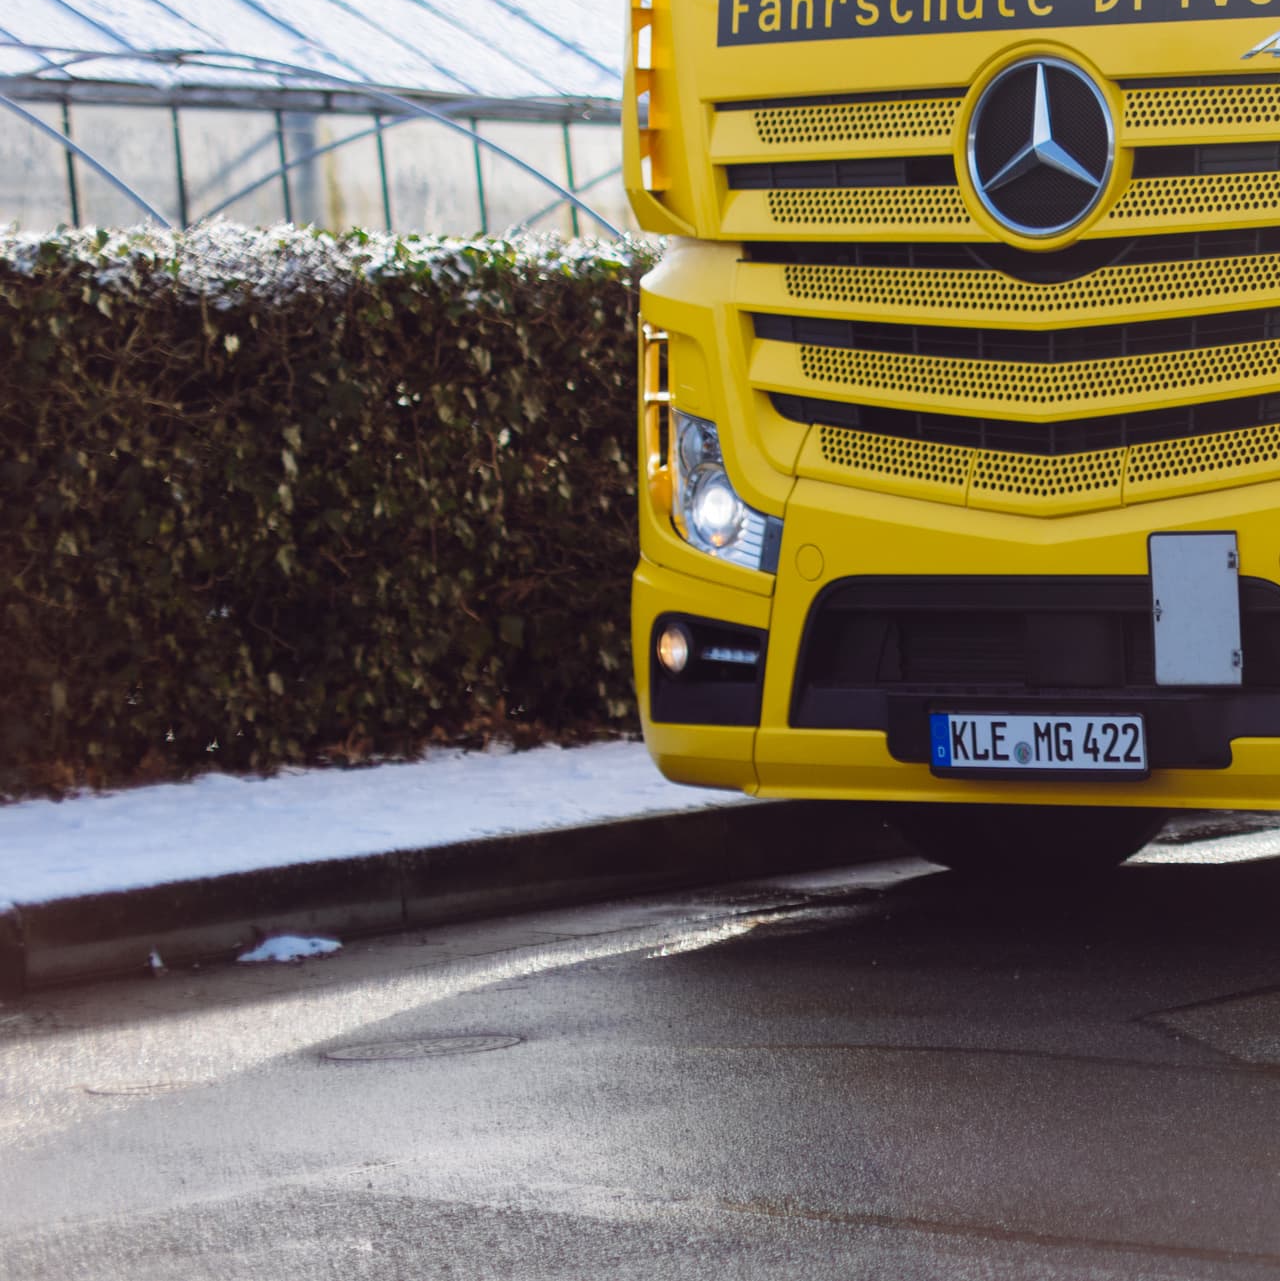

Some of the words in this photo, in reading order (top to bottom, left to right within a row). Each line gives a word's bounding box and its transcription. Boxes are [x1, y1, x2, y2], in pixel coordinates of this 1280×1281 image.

[951, 721, 1009, 761] KLE
[1034, 722, 1073, 761] MG
[1083, 722, 1141, 763] 422
